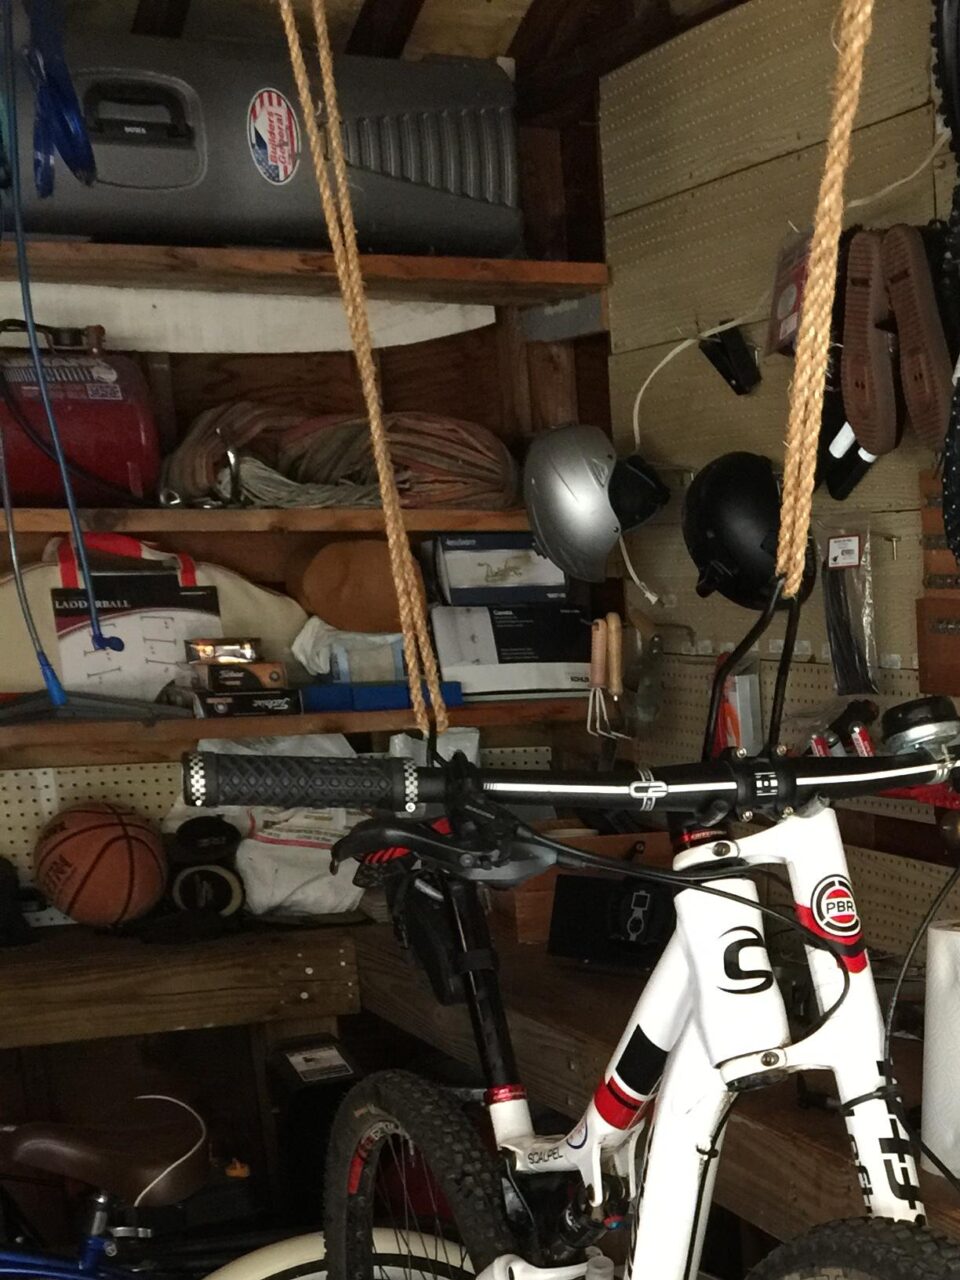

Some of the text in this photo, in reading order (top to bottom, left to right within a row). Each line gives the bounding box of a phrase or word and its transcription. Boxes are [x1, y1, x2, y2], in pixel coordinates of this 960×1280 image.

[55, 600, 131, 609] LADDRBALL
[825, 900, 855, 915] PBR
[527, 1146, 564, 1165] SCALPEL
